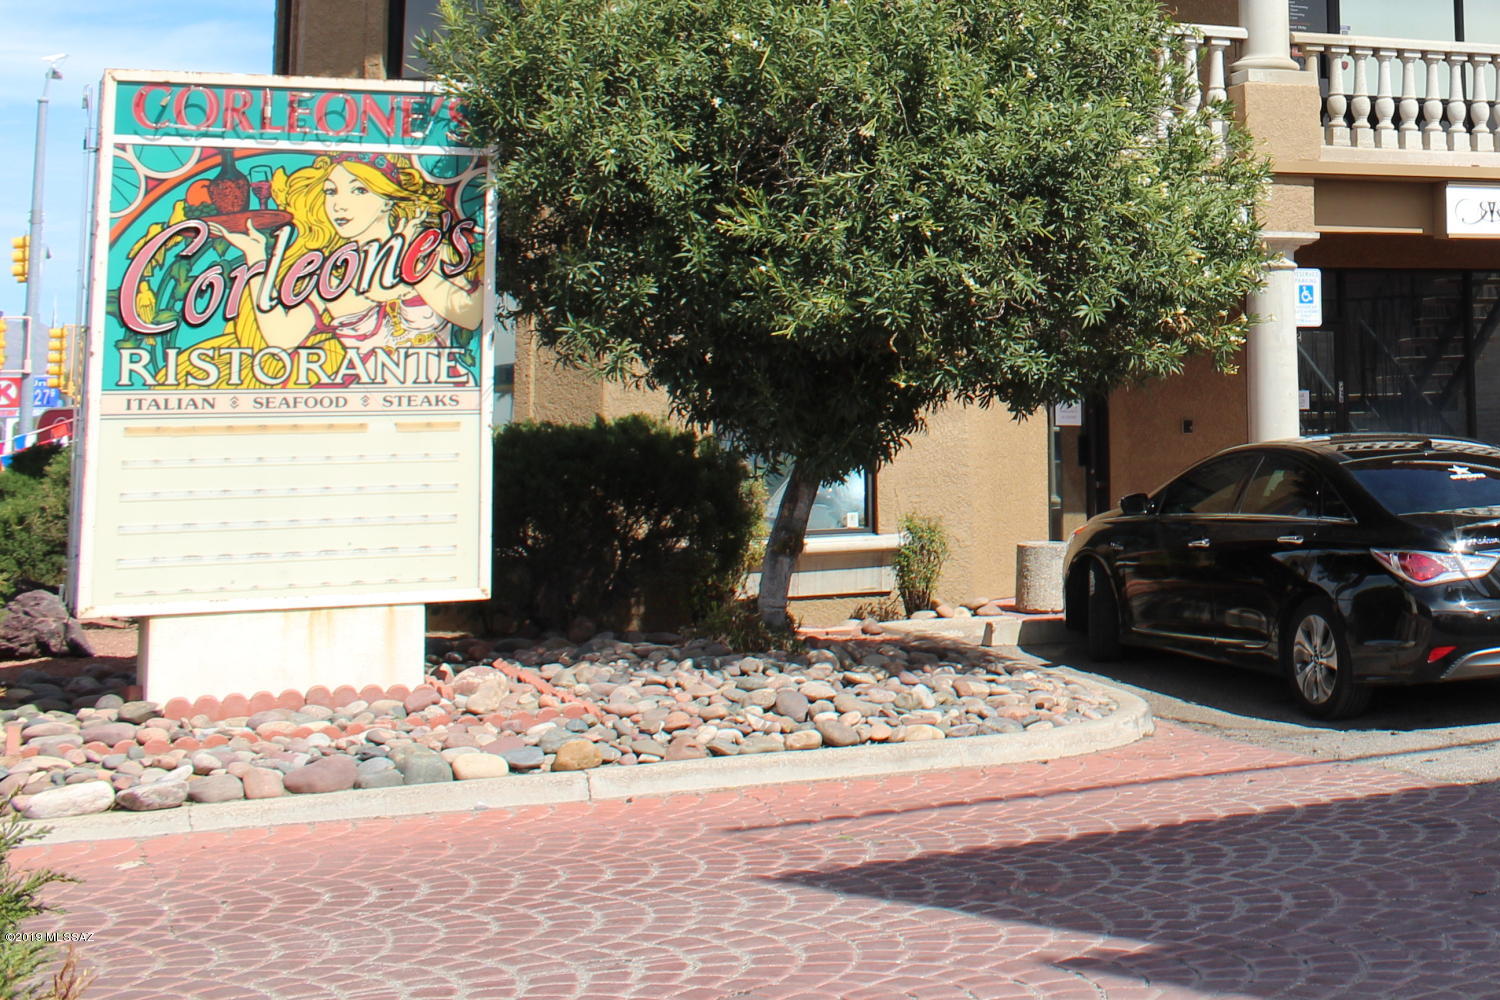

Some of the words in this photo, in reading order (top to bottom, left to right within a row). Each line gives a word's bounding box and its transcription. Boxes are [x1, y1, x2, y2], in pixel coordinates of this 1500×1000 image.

[117, 209, 476, 335] Corleone's
[117, 345, 472, 389] RISTORANTE
[123, 397, 217, 412] ITALIAN
[252, 395, 348, 410] SEAFOOD
[382, 393, 461, 408] STEAKS
